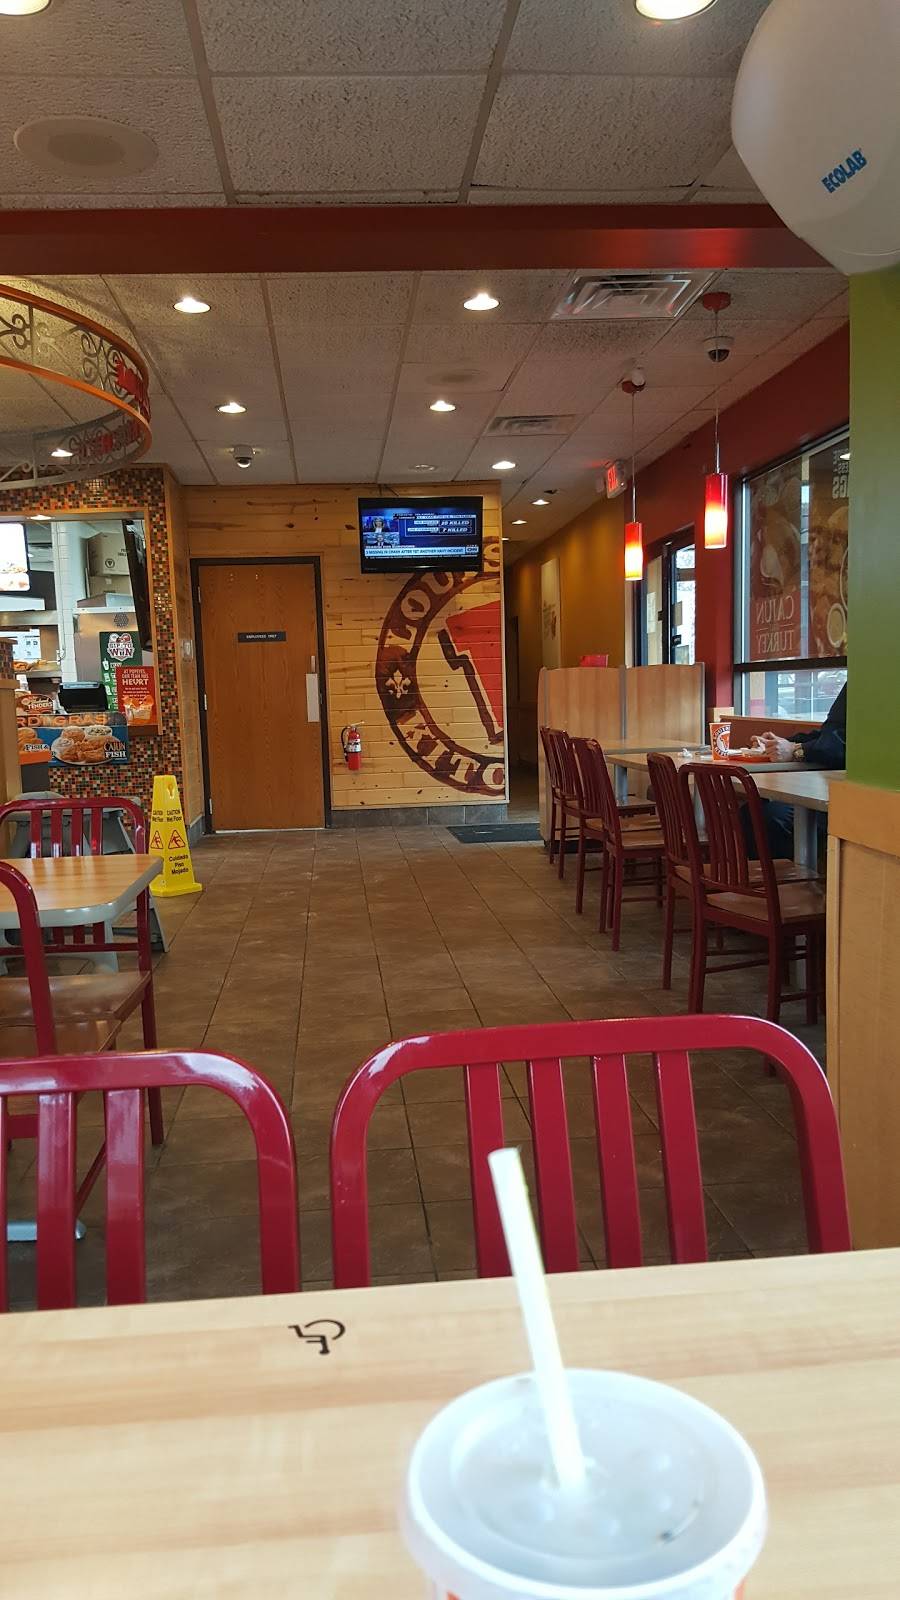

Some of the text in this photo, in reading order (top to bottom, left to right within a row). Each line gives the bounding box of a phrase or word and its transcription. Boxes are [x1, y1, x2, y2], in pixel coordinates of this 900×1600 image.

[821, 150, 867, 193] ECOLAB
[53, 714, 109, 726] GRAS
[104, 741, 126, 751] CAJUN
[105, 750, 127, 758] FISH
